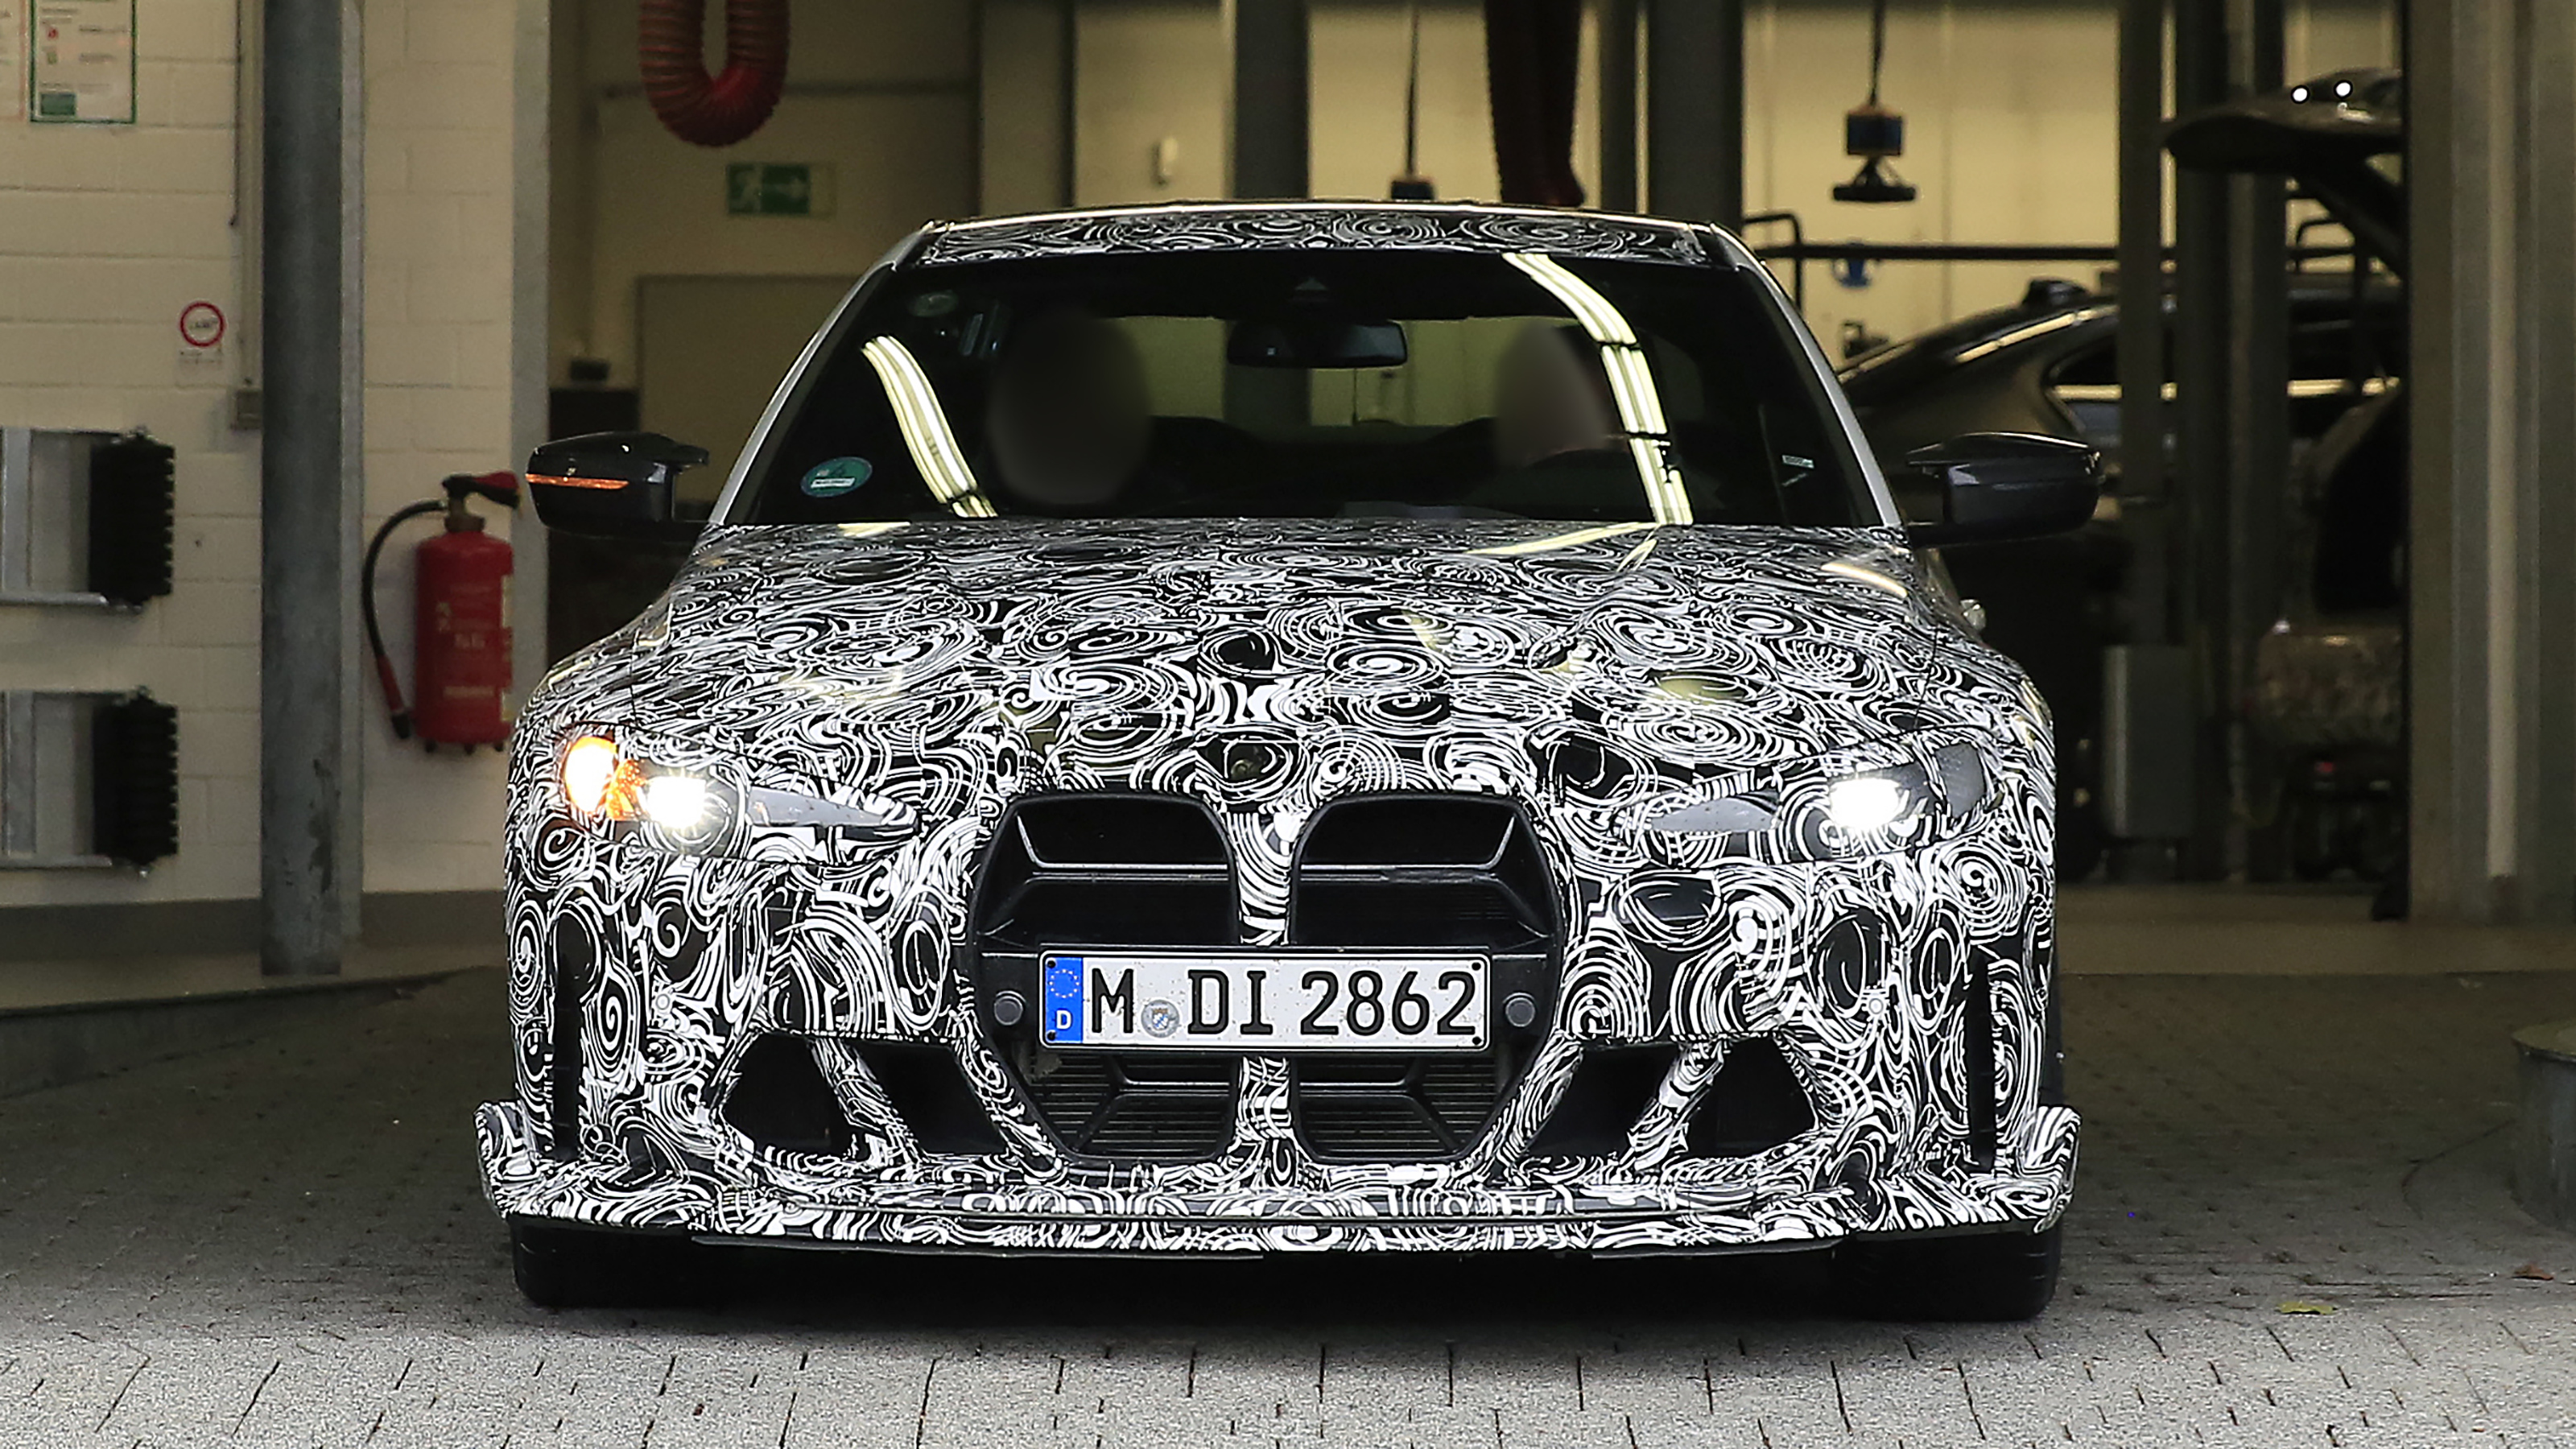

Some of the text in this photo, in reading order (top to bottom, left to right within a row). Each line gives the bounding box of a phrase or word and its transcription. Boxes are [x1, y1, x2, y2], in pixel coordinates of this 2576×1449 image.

[1056, 1009, 1071, 1030] D
[1092, 968, 1476, 1036] M DI 2862
